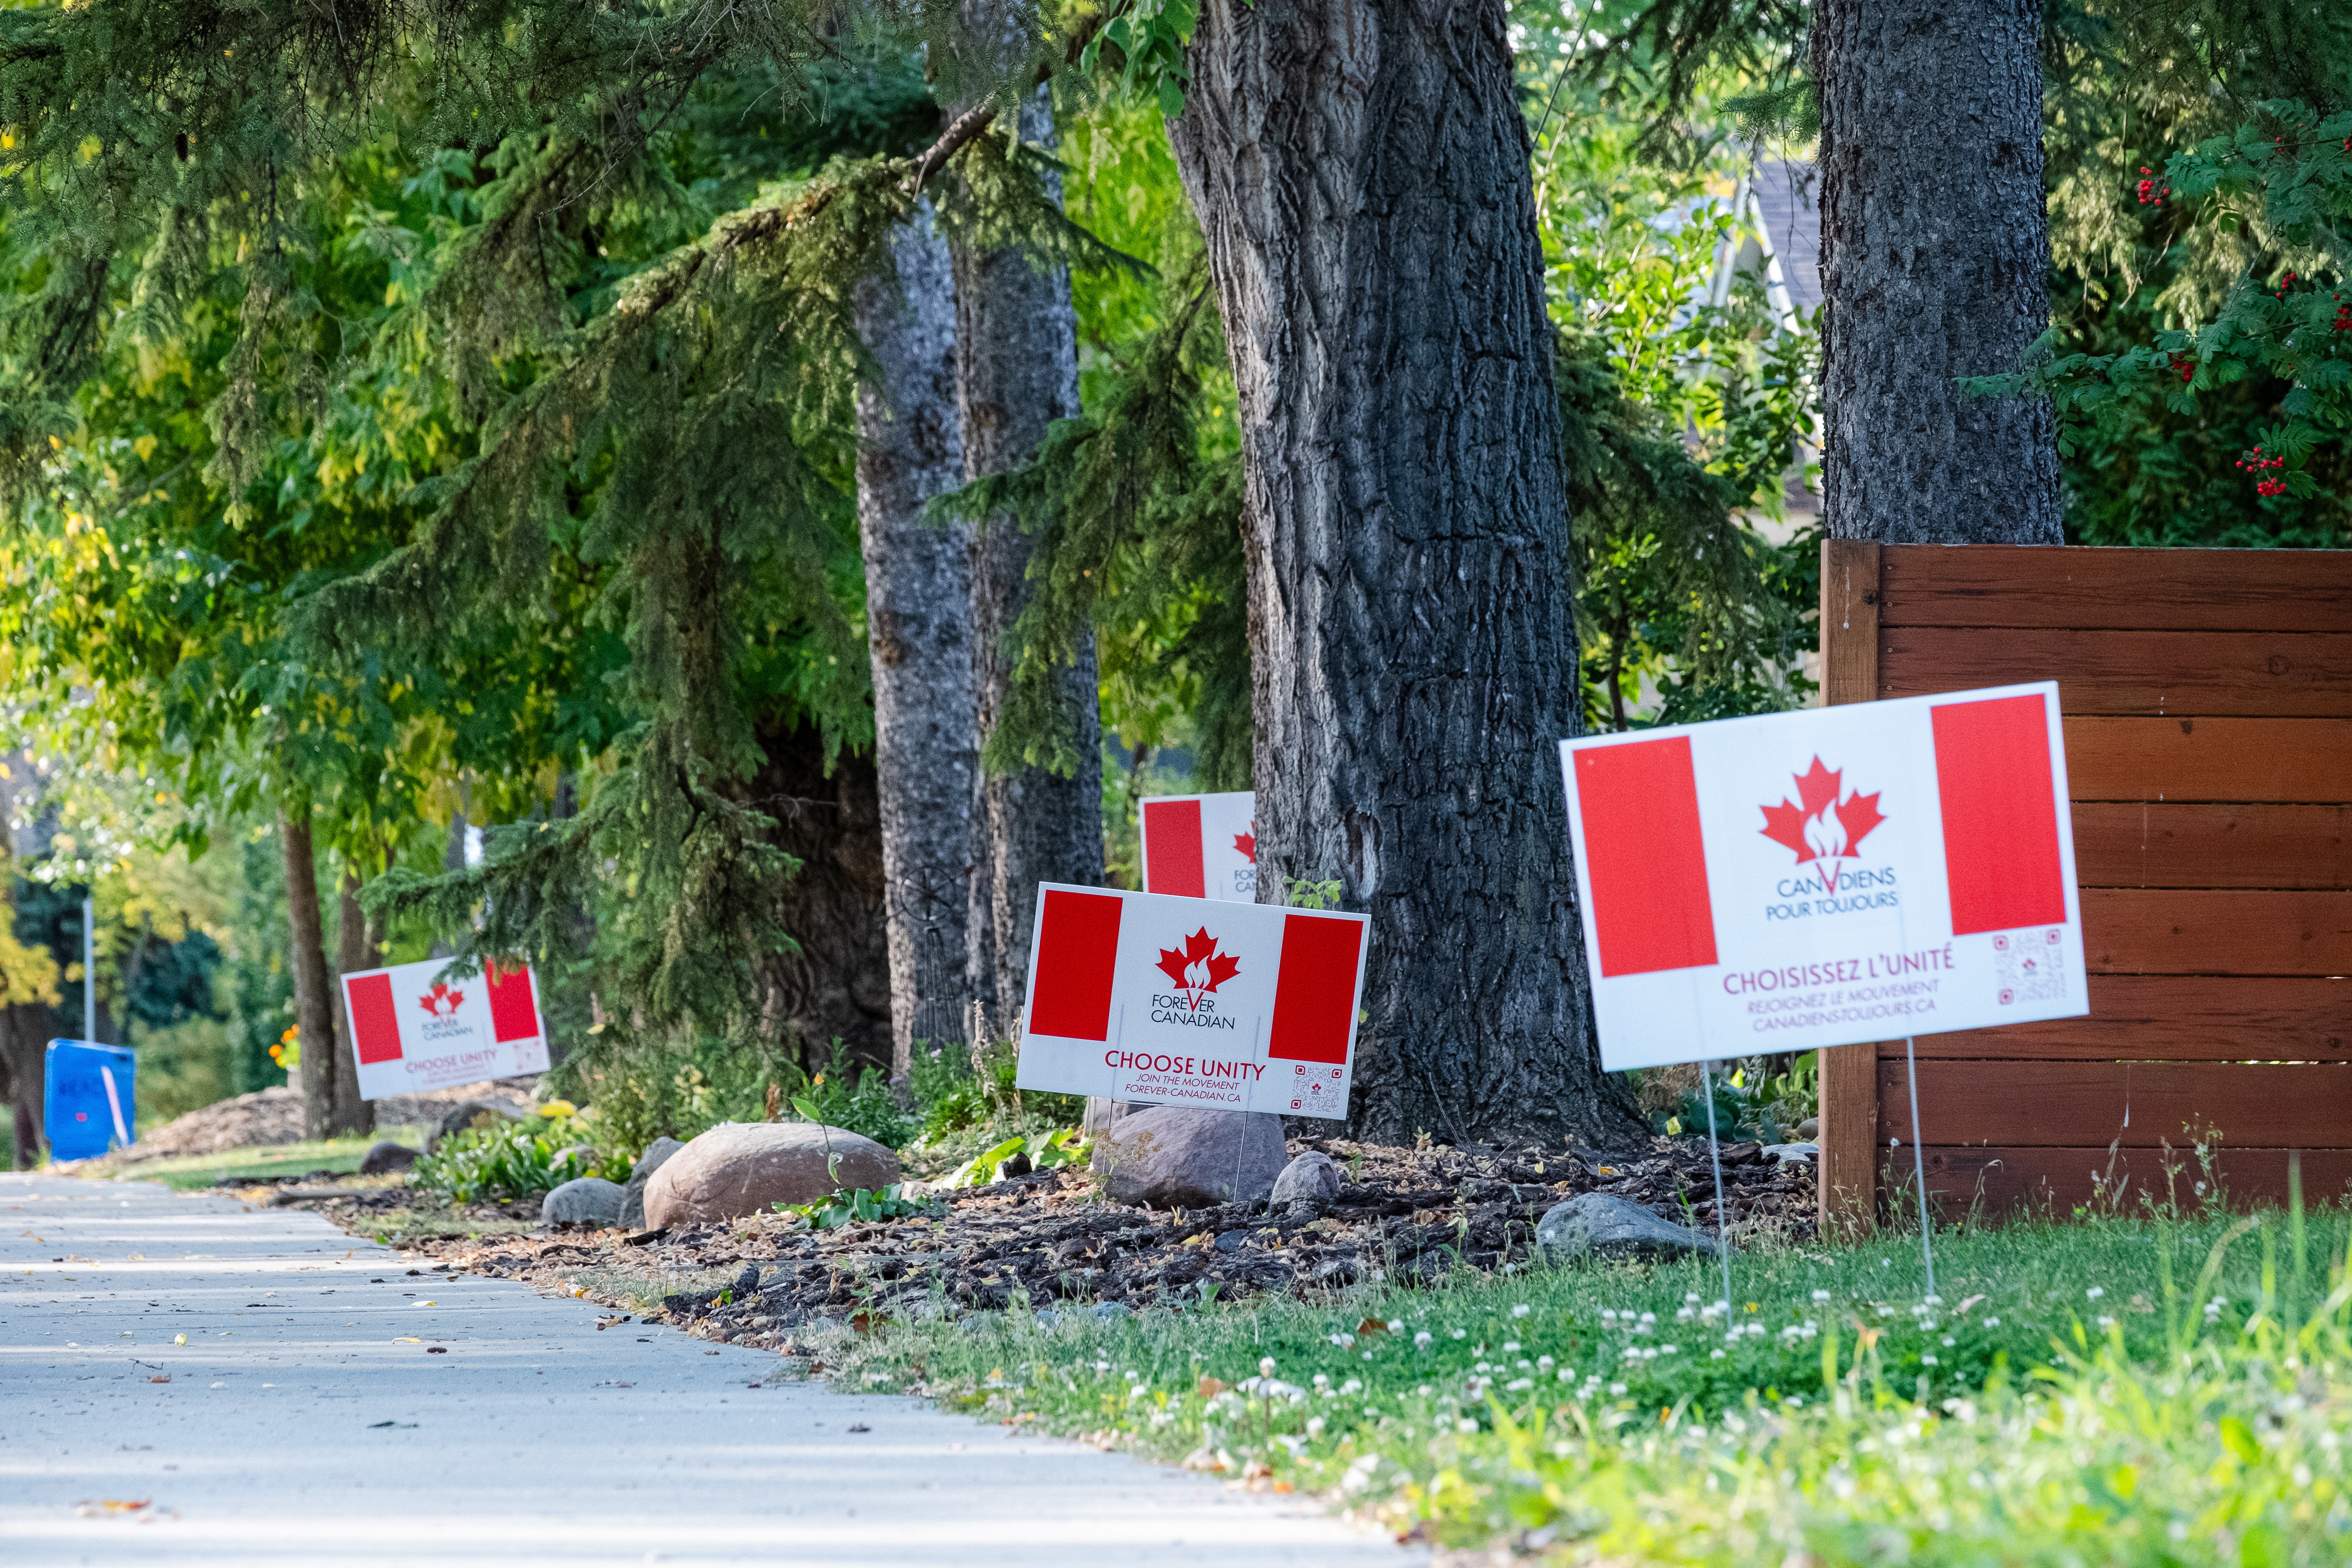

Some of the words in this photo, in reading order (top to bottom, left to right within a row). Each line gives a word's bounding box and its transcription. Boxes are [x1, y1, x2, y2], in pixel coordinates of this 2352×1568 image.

[1766, 901, 1812, 921] POUR
[1815, 891, 1899, 914] TOUJOURS
[1723, 959, 1862, 995] CHOISISSEZ
[1868, 942, 1955, 978] L'UNITÉ
[1152, 989, 1215, 1012] FOREVER
[1748, 992, 1826, 1014] REJOIGNEZ
[1830, 990, 1844, 1005] LE
[1848, 978, 1939, 1001] MOUVEMENT
[1151, 1010, 1235, 1029] CANADIAN
[405, 1055, 457, 1074] CHOOSE
[459, 1049, 497, 1065] UNITY
[1105, 1050, 1194, 1075] CHOOSE
[1201, 1059, 1266, 1081] UNITY
[1125, 1084, 1241, 1102] FOREVER-CANADIAN.CA
[1136, 1074, 1160, 1083] JOIN
[1164, 1075, 1180, 1085] THE
[1182, 1078, 1240, 1091] MOVEMENT
